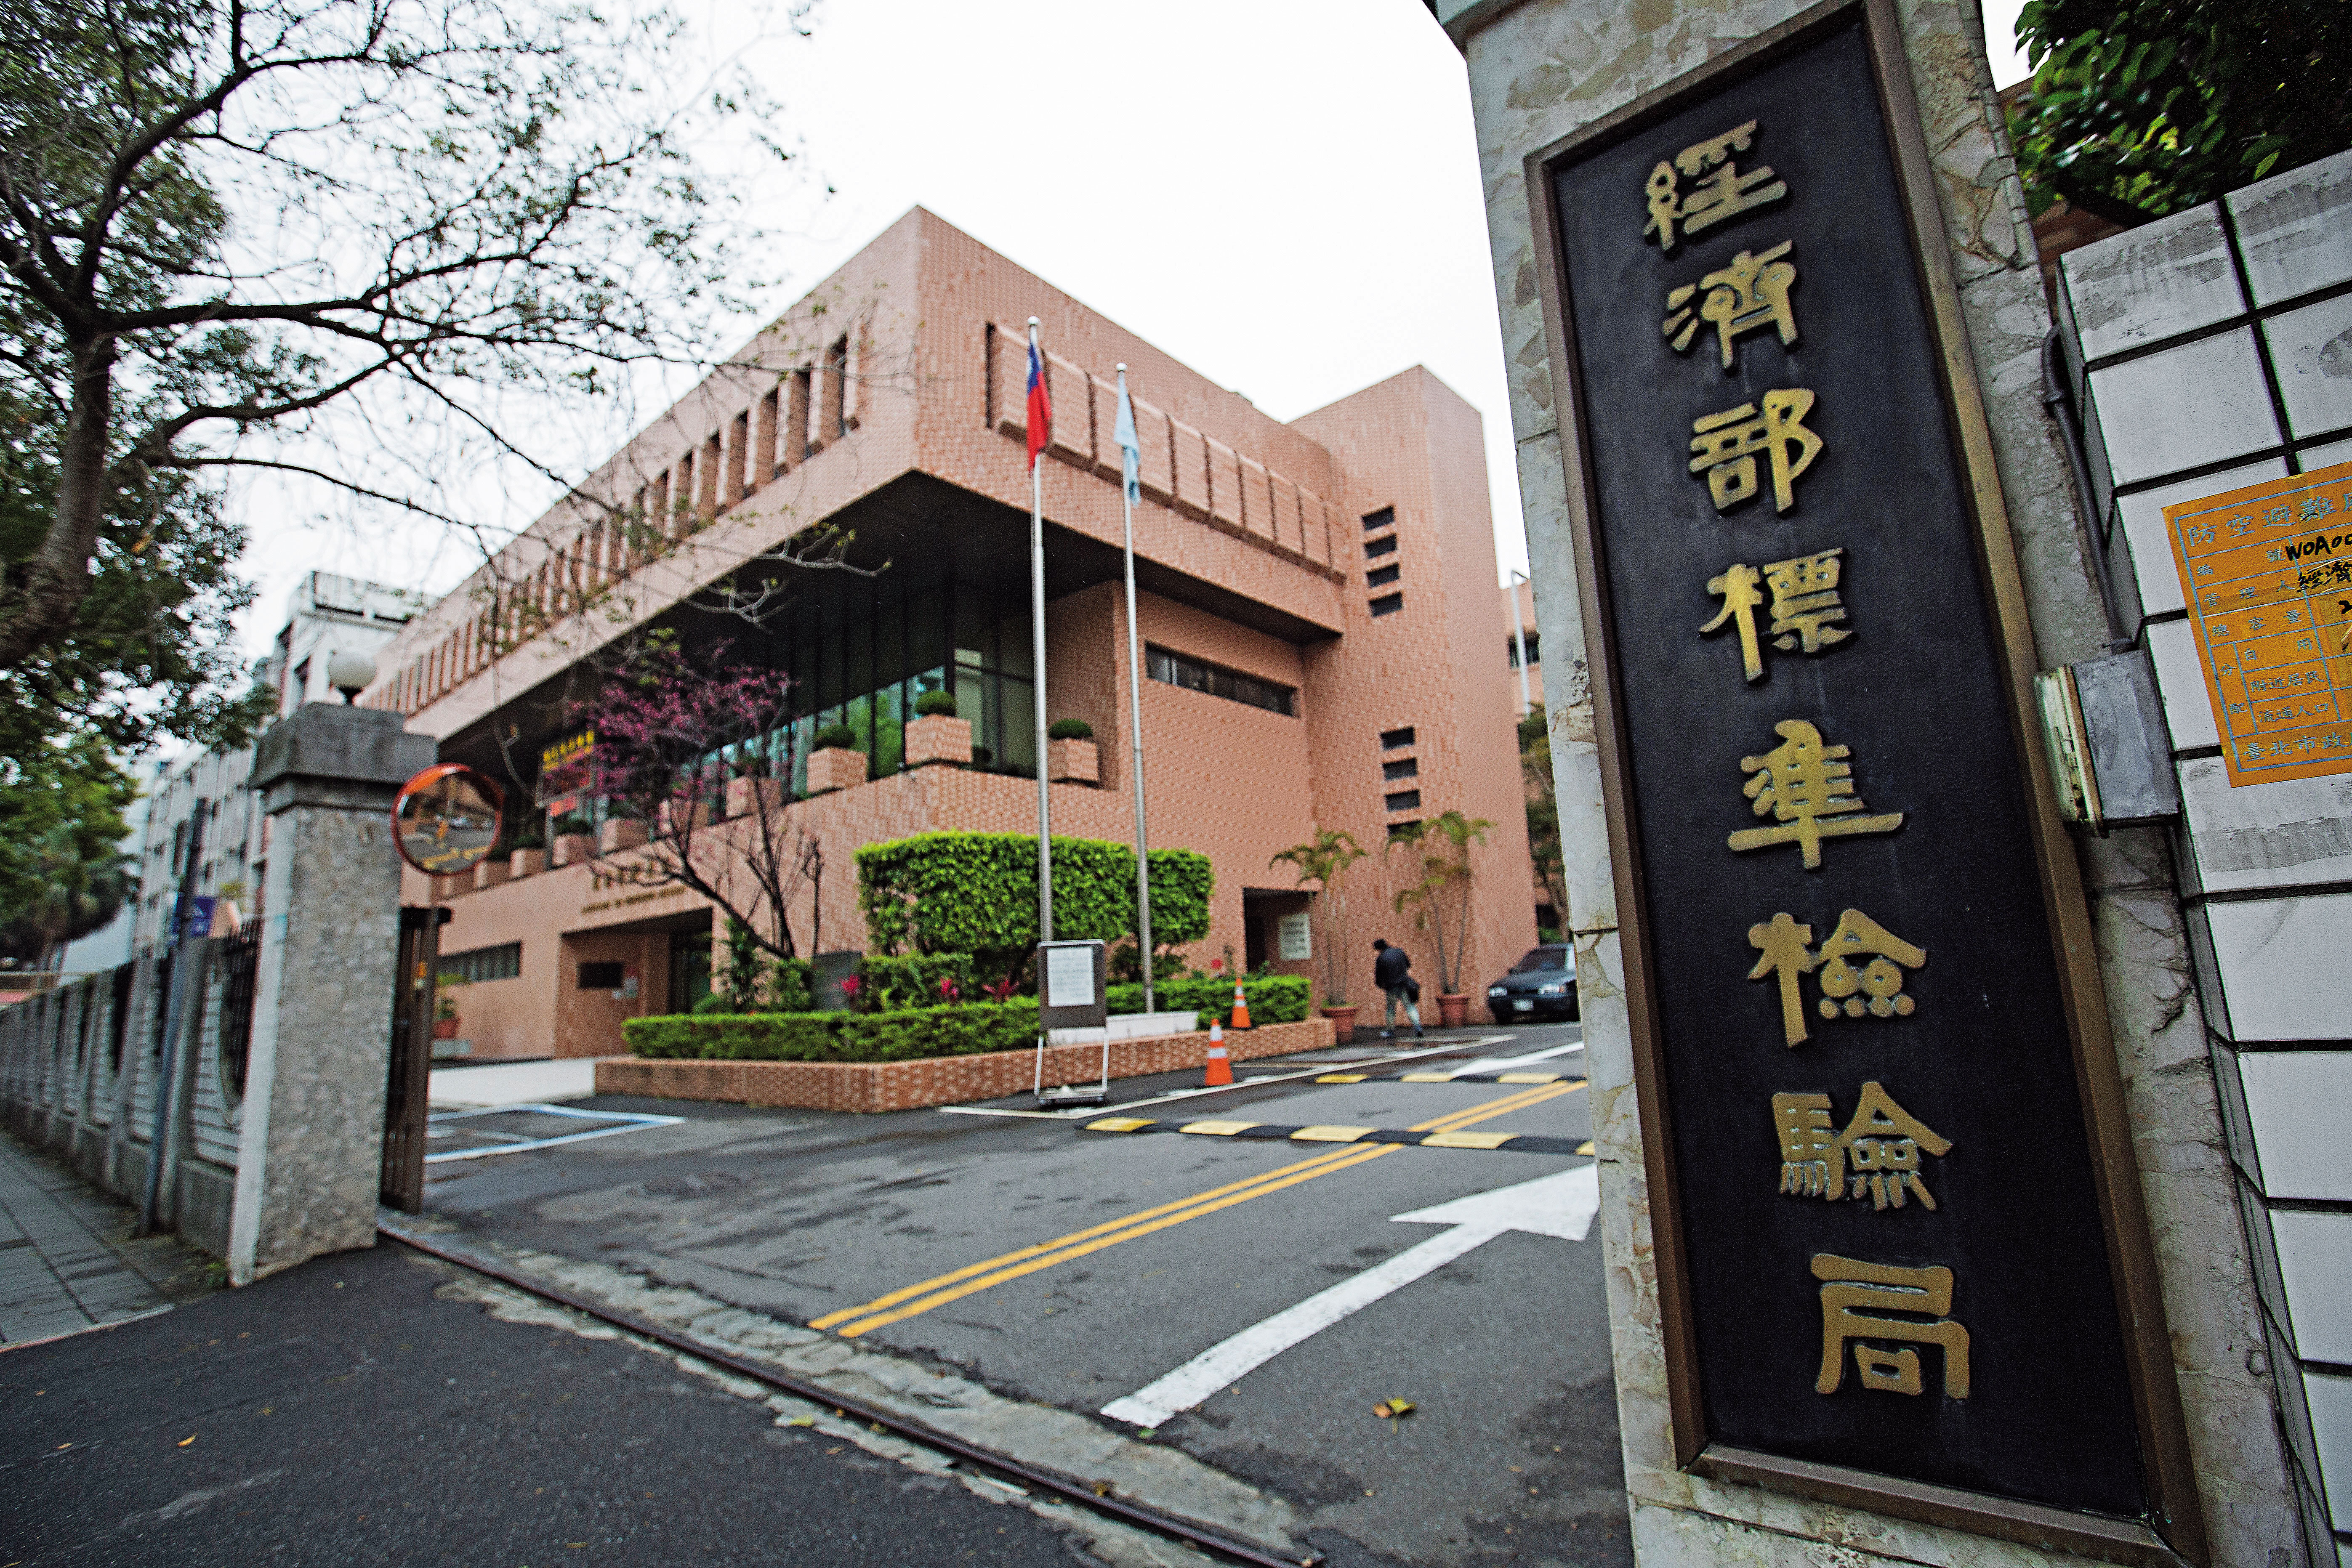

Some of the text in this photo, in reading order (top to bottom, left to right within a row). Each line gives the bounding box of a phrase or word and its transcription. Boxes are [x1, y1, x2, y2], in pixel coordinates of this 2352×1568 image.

[2187, 487, 2352, 547] 防空避難
[2204, 580, 2296, 607] 管理人
[2212, 610, 2302, 636] 總容量
[2244, 638, 2312, 661] 自用
[2250, 670, 2325, 693] 附近居民
[2259, 703, 2329, 723] 流通人口
[1644, 119, 1971, 1401] 經濟部標準檢驗局
[2243, 732, 2352, 762] 臺北市政
